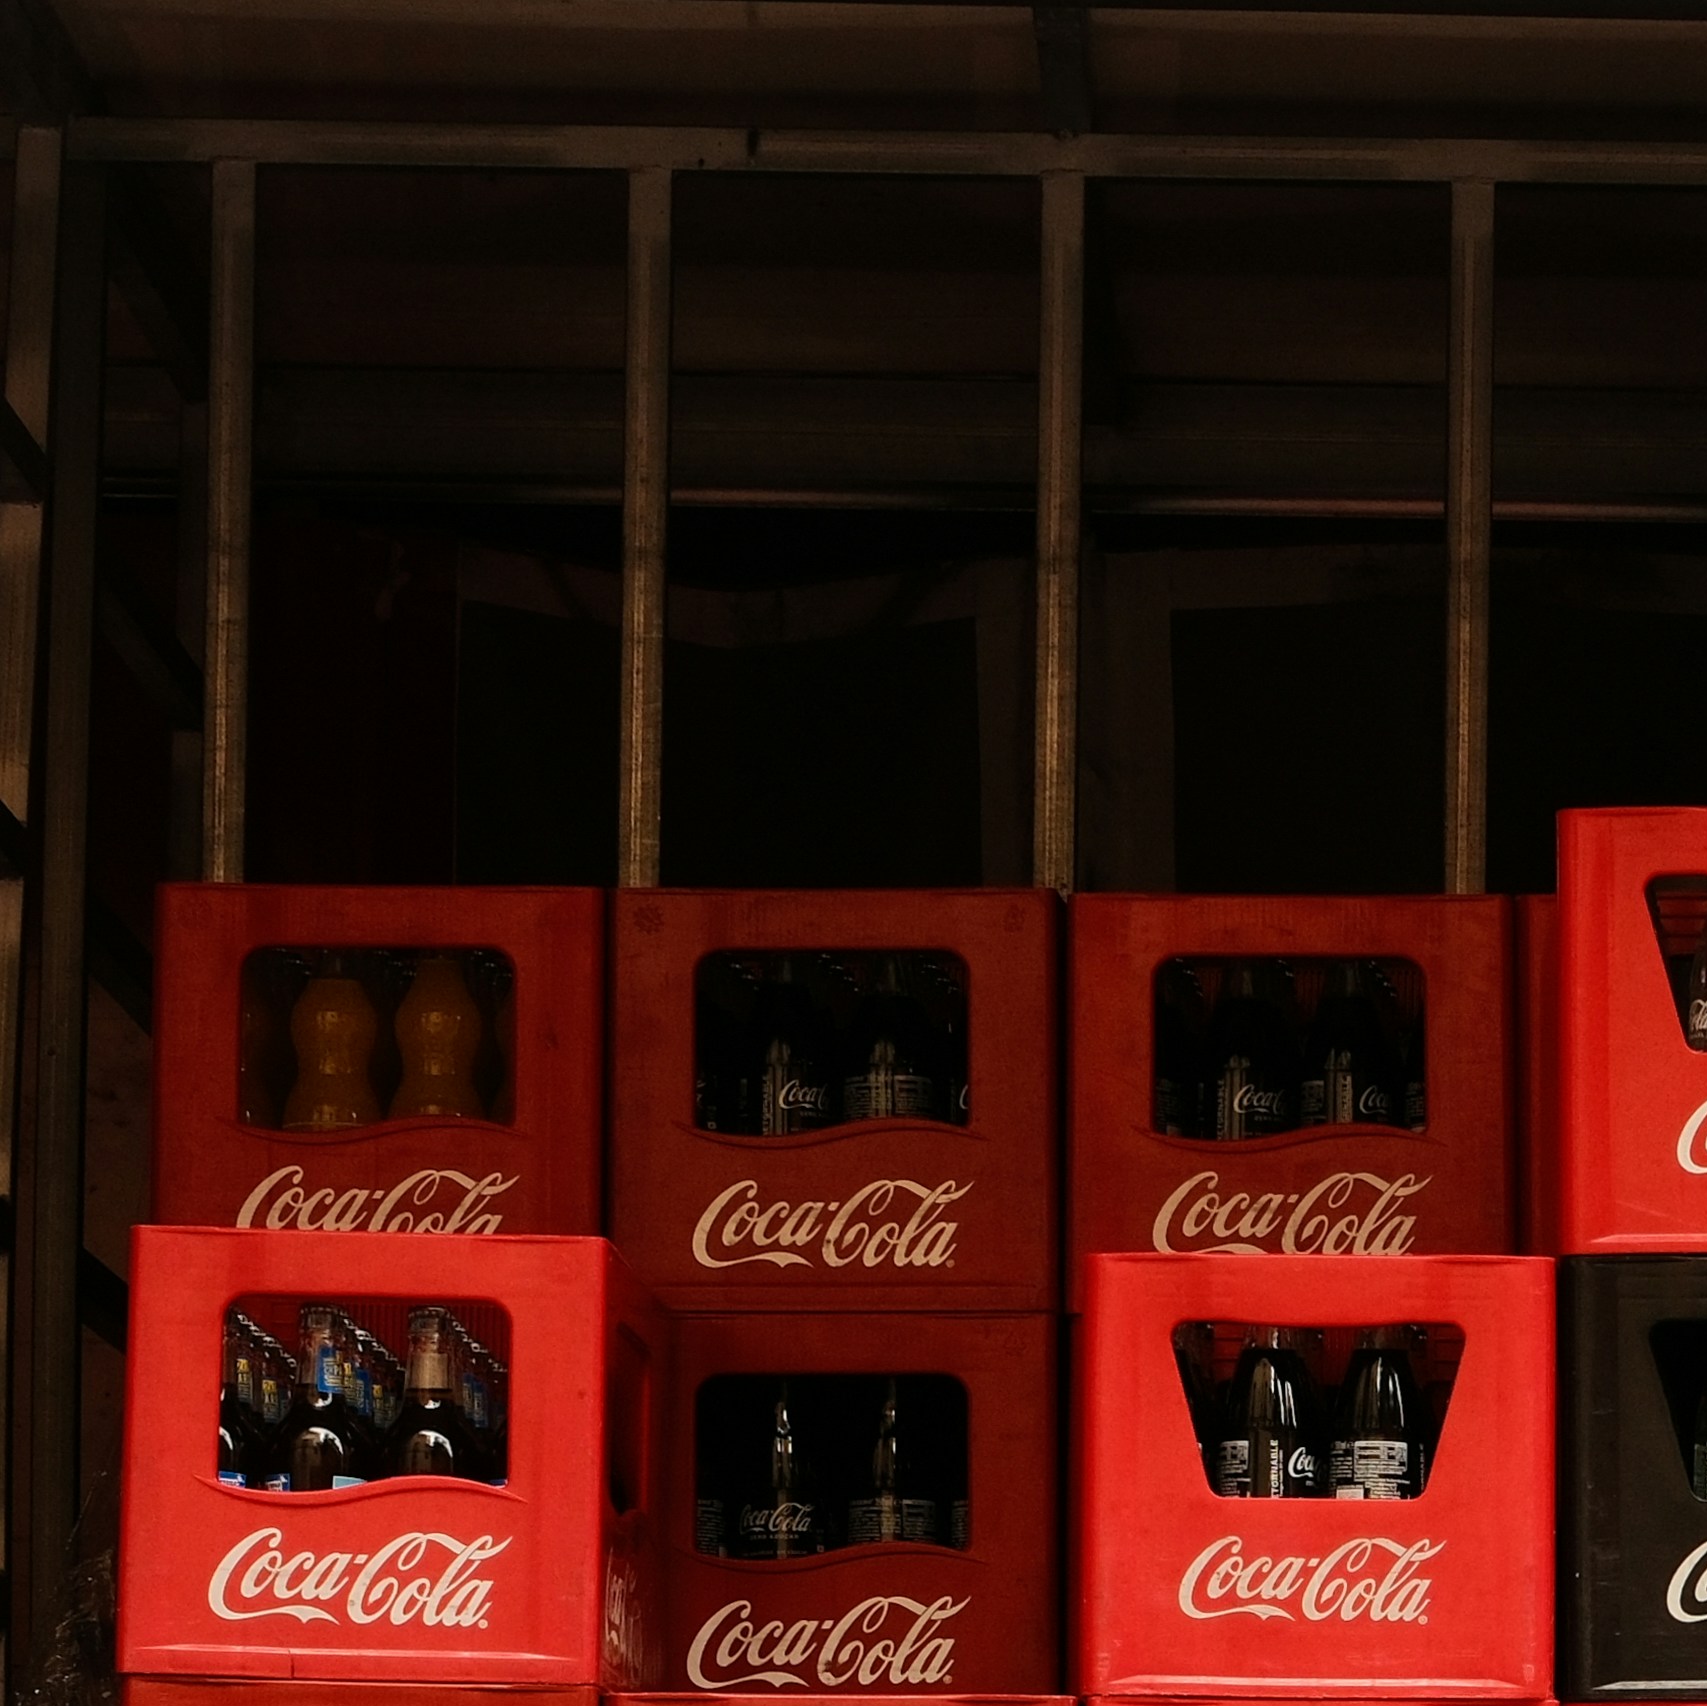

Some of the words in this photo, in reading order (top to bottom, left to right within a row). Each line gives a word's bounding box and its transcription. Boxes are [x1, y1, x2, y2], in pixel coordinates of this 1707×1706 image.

[693, 1180, 972, 1267] Coca-Cola
[208, 1528, 511, 1628] Coca-Cola
[1179, 1536, 1444, 1624] Coca-Cola
[687, 1596, 970, 1688] Coca-Cola
